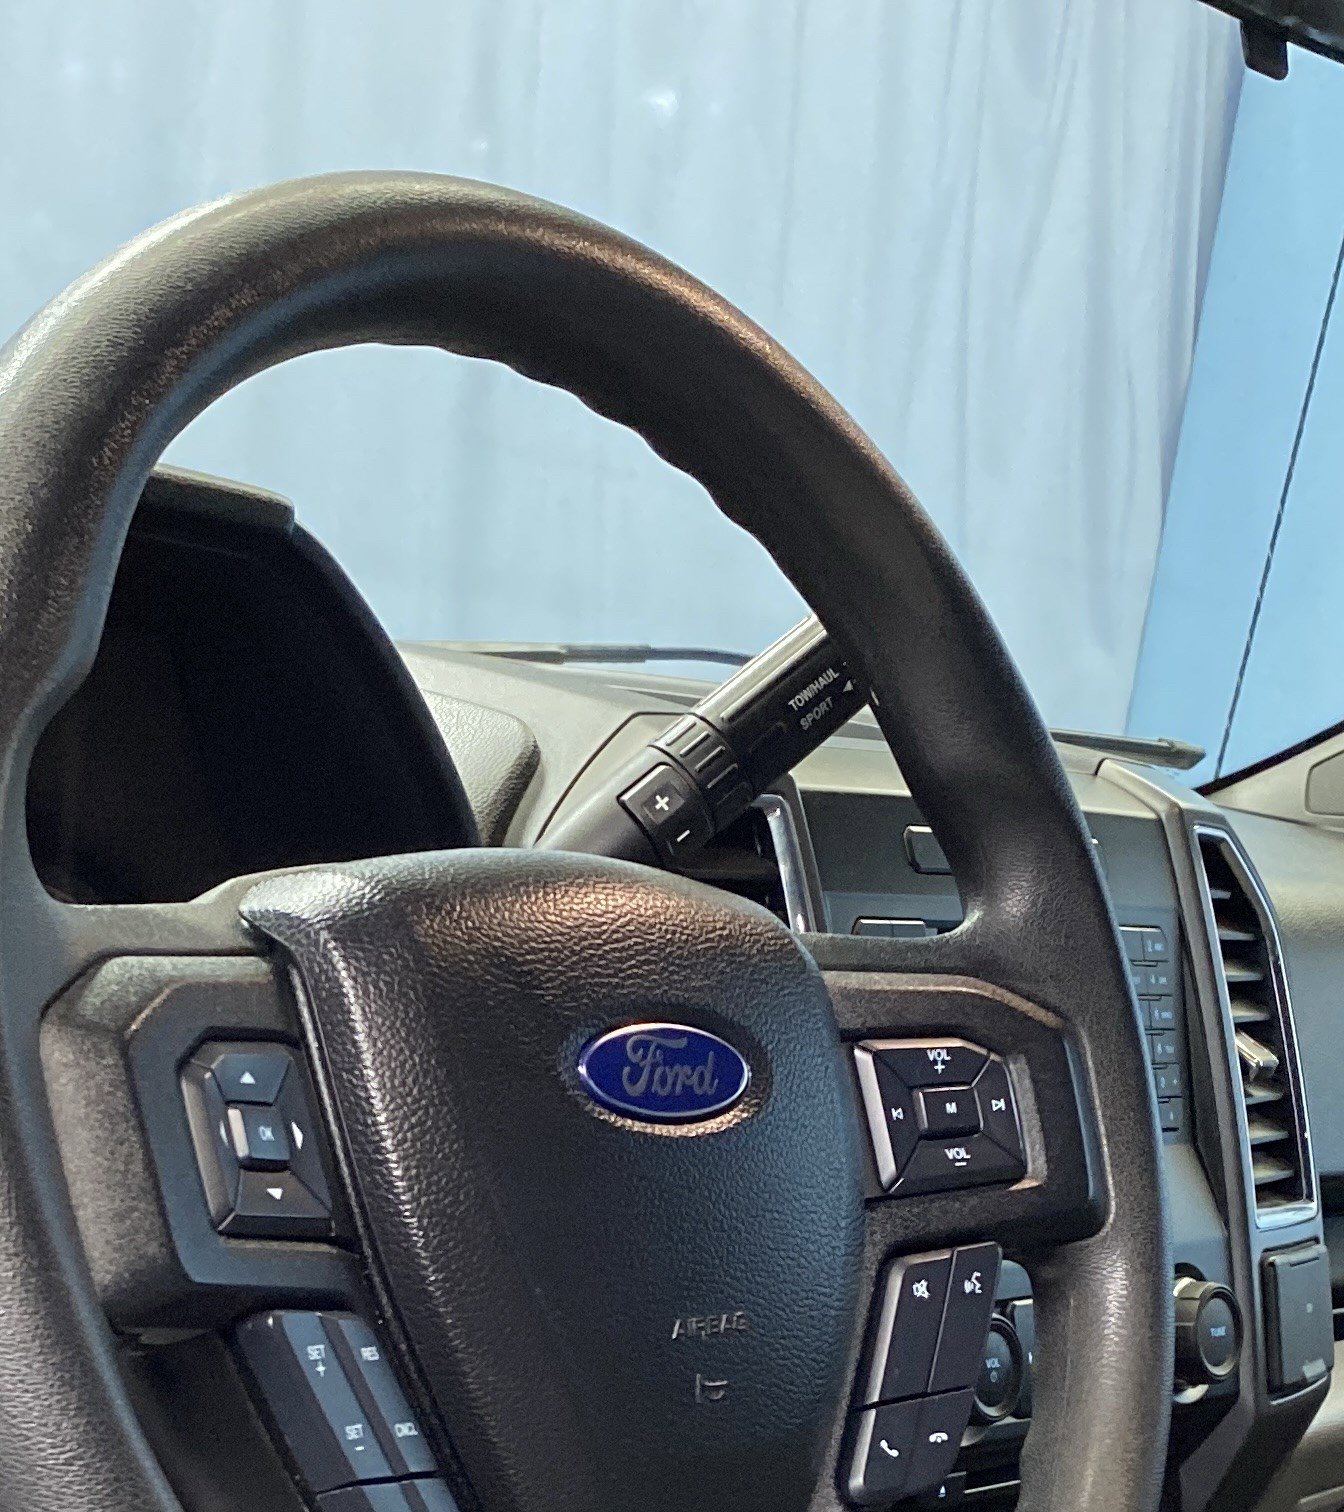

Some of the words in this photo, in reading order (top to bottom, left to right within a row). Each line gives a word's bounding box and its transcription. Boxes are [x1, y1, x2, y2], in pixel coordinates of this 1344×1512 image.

[800, 696, 833, 731] SPORT
[927, 1049, 952, 1061] VOL
[622, 1034, 719, 1097] Ford
[945, 1102, 957, 1114] M
[258, 1125, 275, 1141] OK
[945, 1148, 971, 1160] VOL
[307, 1344, 325, 1360] SET
[360, 1346, 380, 1360] RES
[345, 1423, 363, 1440] SET
